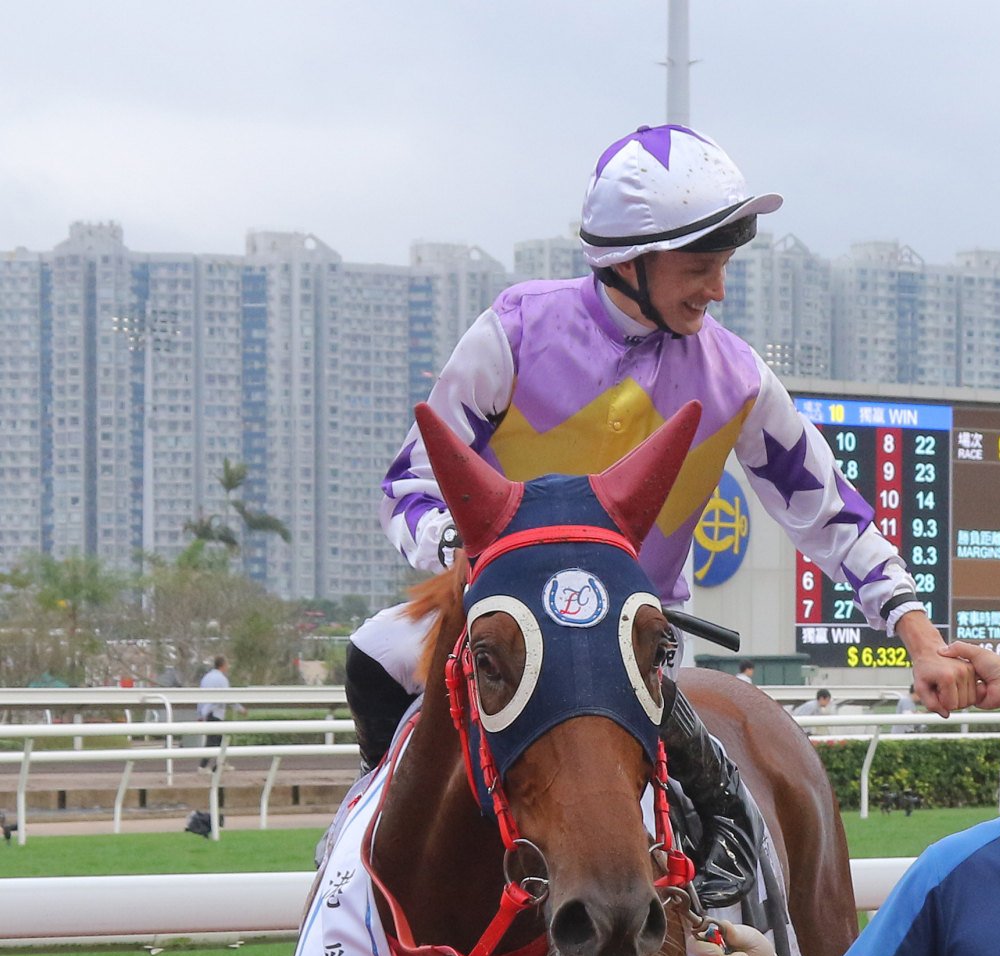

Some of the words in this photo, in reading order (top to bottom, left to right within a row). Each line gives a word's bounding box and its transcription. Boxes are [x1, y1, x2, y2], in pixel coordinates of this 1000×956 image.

[829, 404, 845, 422] 10
[889, 409, 918, 425] WIN
[836, 432, 856, 452] 10
[883, 434, 895, 453] 8
[915, 436, 936, 455] 22
[957, 448, 983, 460] RACE
[883, 462, 895, 481] 9
[915, 463, 936, 483] 23
[880, 490, 899, 509] 10
[916, 492, 936, 510] 14
[880, 518, 897, 536] 11
[912, 519, 938, 538] 9.3
[912, 546, 938, 566] 8.3
[802, 572, 814, 591] 6
[915, 574, 936, 593] 28
[802, 600, 814, 619] 7
[834, 600, 855, 619] 27
[831, 628, 861, 645] WIN
[957, 627, 986, 639] RACE
[847, 646, 859, 667] $
[861, 647, 913, 667] 6,332,
